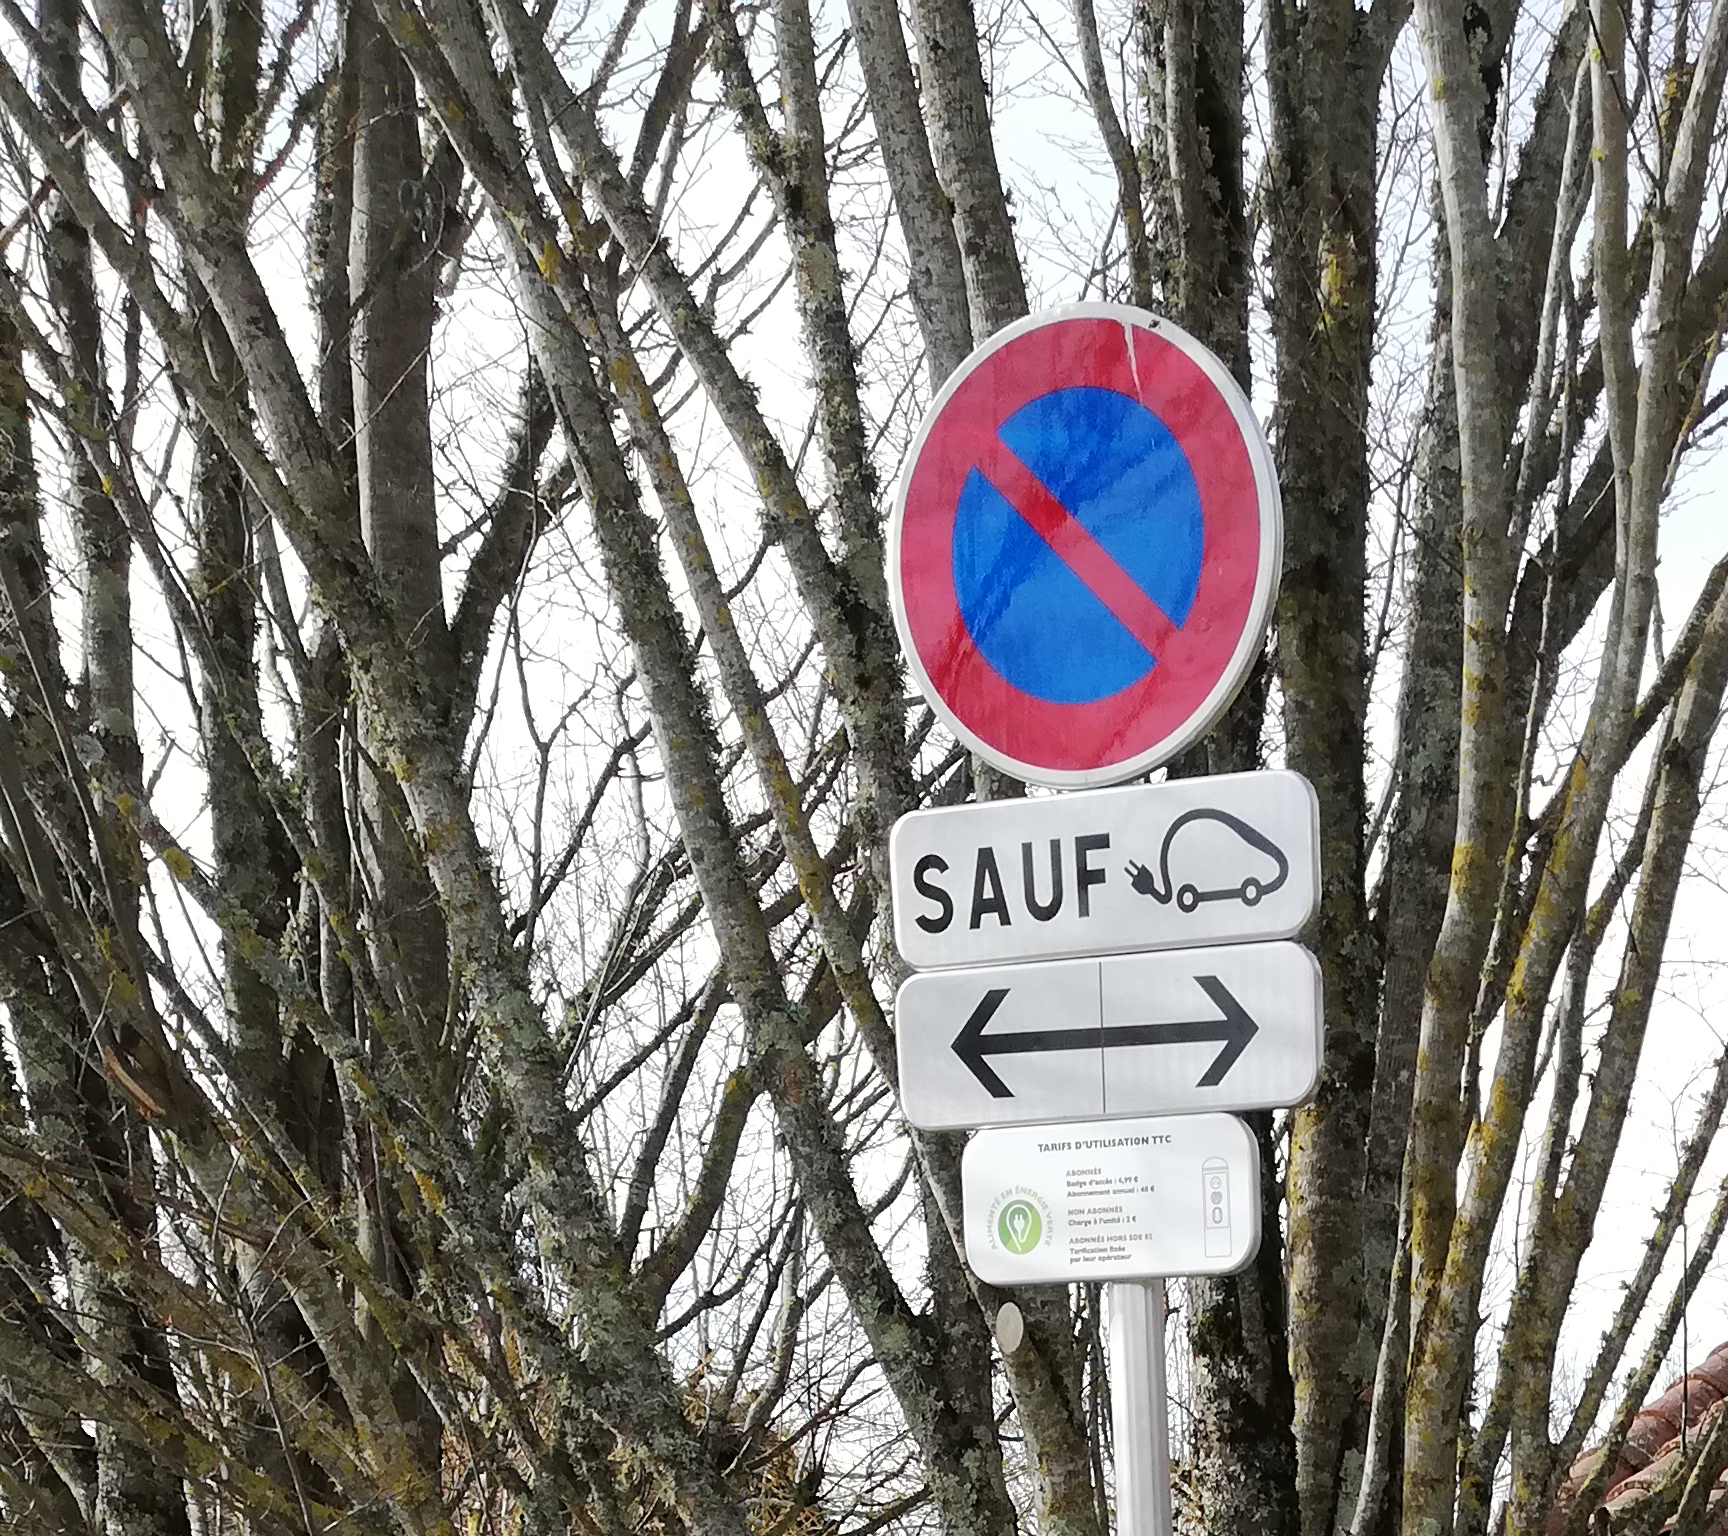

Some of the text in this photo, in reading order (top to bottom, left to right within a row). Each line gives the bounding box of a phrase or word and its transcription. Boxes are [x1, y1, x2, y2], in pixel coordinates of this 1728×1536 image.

[913, 832, 1111, 934] SAUF
[1038, 1135, 1172, 1153] TARIFS D'UTILISATION TTC
[1066, 1180, 1087, 1188] Badge
[1000, 1188, 1013, 1199] EN
[1044, 1212, 1053, 1247] VERTE
[1068, 1206, 1123, 1216] NON ABONNÉS
[1069, 1234, 1105, 1244] ABONNÉS
[1107, 1234, 1127, 1242] HORS
